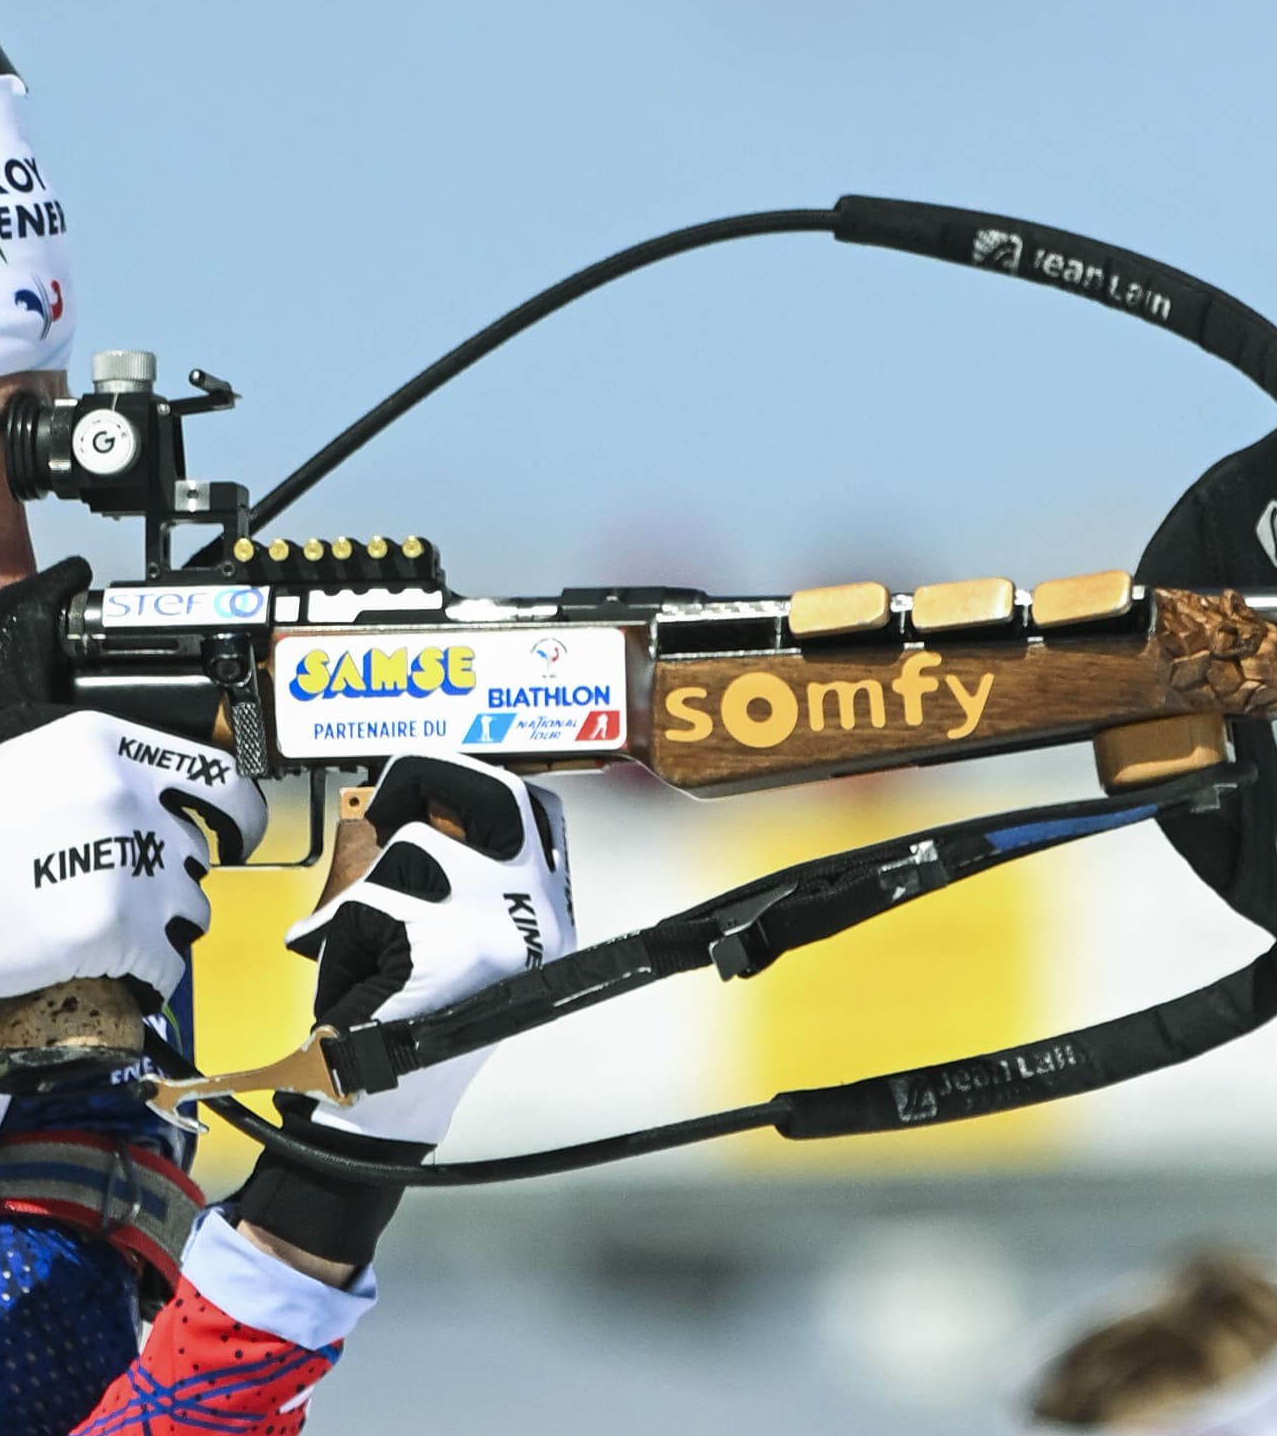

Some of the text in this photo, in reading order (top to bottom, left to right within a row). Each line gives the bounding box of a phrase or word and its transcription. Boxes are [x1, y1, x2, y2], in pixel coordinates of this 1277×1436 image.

[289, 646, 476, 701] SAMSE
[487, 685, 611, 708] BIATHLON
[664, 651, 995, 749] somfy
[313, 720, 447, 740] PARTENAIRE DU
